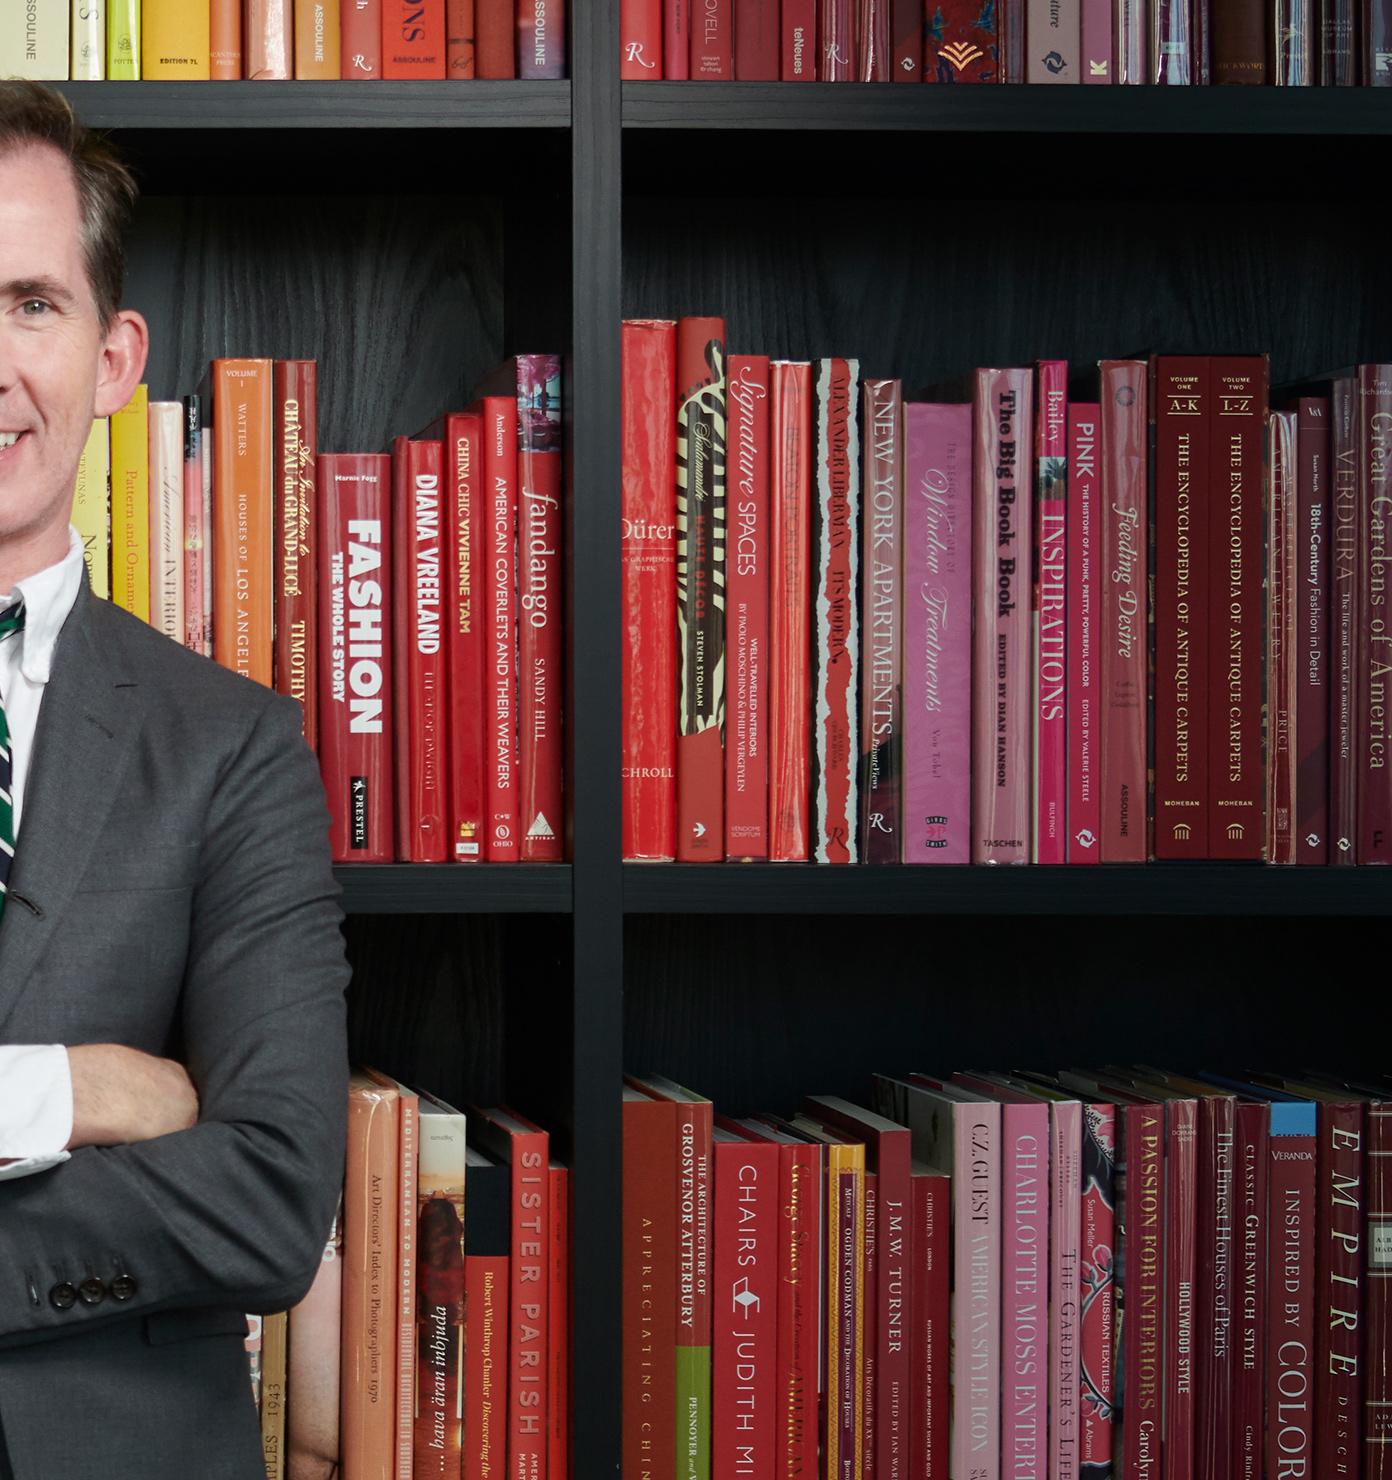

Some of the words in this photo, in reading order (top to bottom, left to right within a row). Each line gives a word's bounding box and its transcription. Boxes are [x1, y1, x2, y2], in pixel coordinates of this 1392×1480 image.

[314, 4, 324, 62] ASSOULINE
[393, 56, 436, 64] ASSOULINE
[793, 27, 804, 74] teNeues
[496, 413, 505, 456] Anderson
[728, 367, 768, 503] Signature
[874, 401, 894, 464] NEW
[999, 390, 1016, 435] The
[1042, 390, 1063, 444] Bailey
[457, 437, 469, 480] CHINA
[996, 440, 1016, 479] Big
[1077, 423, 1094, 478] PINK
[1178, 433, 1189, 466] THE
[1371, 412, 1392, 491] Great
[416, 475, 438, 544] DIANA
[458, 483, 470, 516] CHIC
[495, 477, 507, 553] AMERICAN
[873, 476, 893, 547] YORK
[999, 486, 1016, 546] Book
[459, 518, 470, 595] VIVIENNE
[521, 484, 557, 627] fandango
[738, 502, 756, 576] SPACES
[1112, 502, 1139, 584] Feeding
[1178, 472, 1189, 597] ENCYCLOPEDIA
[1307, 504, 1321, 585] 18th-Century
[1370, 496, 1392, 606] Gardens
[332, 552, 344, 584] THE
[496, 558, 508, 639] COVERLETS
[999, 557, 1016, 617] Book
[332, 587, 344, 645] WHOLE
[347, 520, 382, 734] FASHION
[416, 547, 440, 654] VREELAND
[460, 599, 470, 633] TAM
[1040, 514, 1065, 721] INSPIRATIONS
[1119, 591, 1137, 657] Desire
[1178, 603, 1188, 623] OF
[1310, 589, 1321, 632] Fashion
[1371, 619, 1392, 645] of
[497, 642, 508, 675] AND
[872, 560, 893, 735] APARTMENTS
[1175, 628, 1188, 702] ANTIQUE
[1310, 637, 1320, 646] in
[1310, 651, 1320, 685] Detail
[333, 648, 345, 702] STORY
[497, 678, 509, 720] THEIR
[535, 659, 545, 704] SANDY
[750, 638, 758, 712] WELL-TRAVELLED
[535, 710, 545, 743] HILL
[749, 713, 757, 758] INTERIORS
[1177, 707, 1188, 781] CARPETS
[1370, 660, 1391, 769] America
[497, 722, 509, 788] WEAVERS
[353, 792, 367, 846] PRESTEL
[1120, 784, 1128, 836] ASSOULINE
[682, 1124, 693, 1223] GROSVENOR
[698, 1155, 706, 1179] THE
[1272, 1151, 1312, 1160] VERANDA
[517, 1152, 542, 1284] SISTER
[738, 1165, 757, 1265] CHAIRS
[972, 1160, 989, 1224] GUEST
[1016, 1135, 1039, 1295] CHARLOTTE
[698, 1183, 706, 1275] ARCHITECTURE
[1284, 1190, 1299, 1292] INSPIRED
[1330, 1126, 1360, 1376] EMPIRE
[484, 1272, 493, 1306] Robert
[682, 1229, 693, 1327] ATTERBURY
[698, 1279, 705, 1295] OF
[482, 1309, 493, 1356] Winthrop
[889, 1267, 901, 1353] TURNER
[1016, 1305, 1036, 1375] MOSS
[1285, 1304, 1299, 1327] BY
[483, 1358, 492, 1397] Chanler
[519, 1304, 540, 1434] PARISH
[733, 1331, 755, 1429] JUDITH
[1278, 1341, 1307, 1480] COLOR
